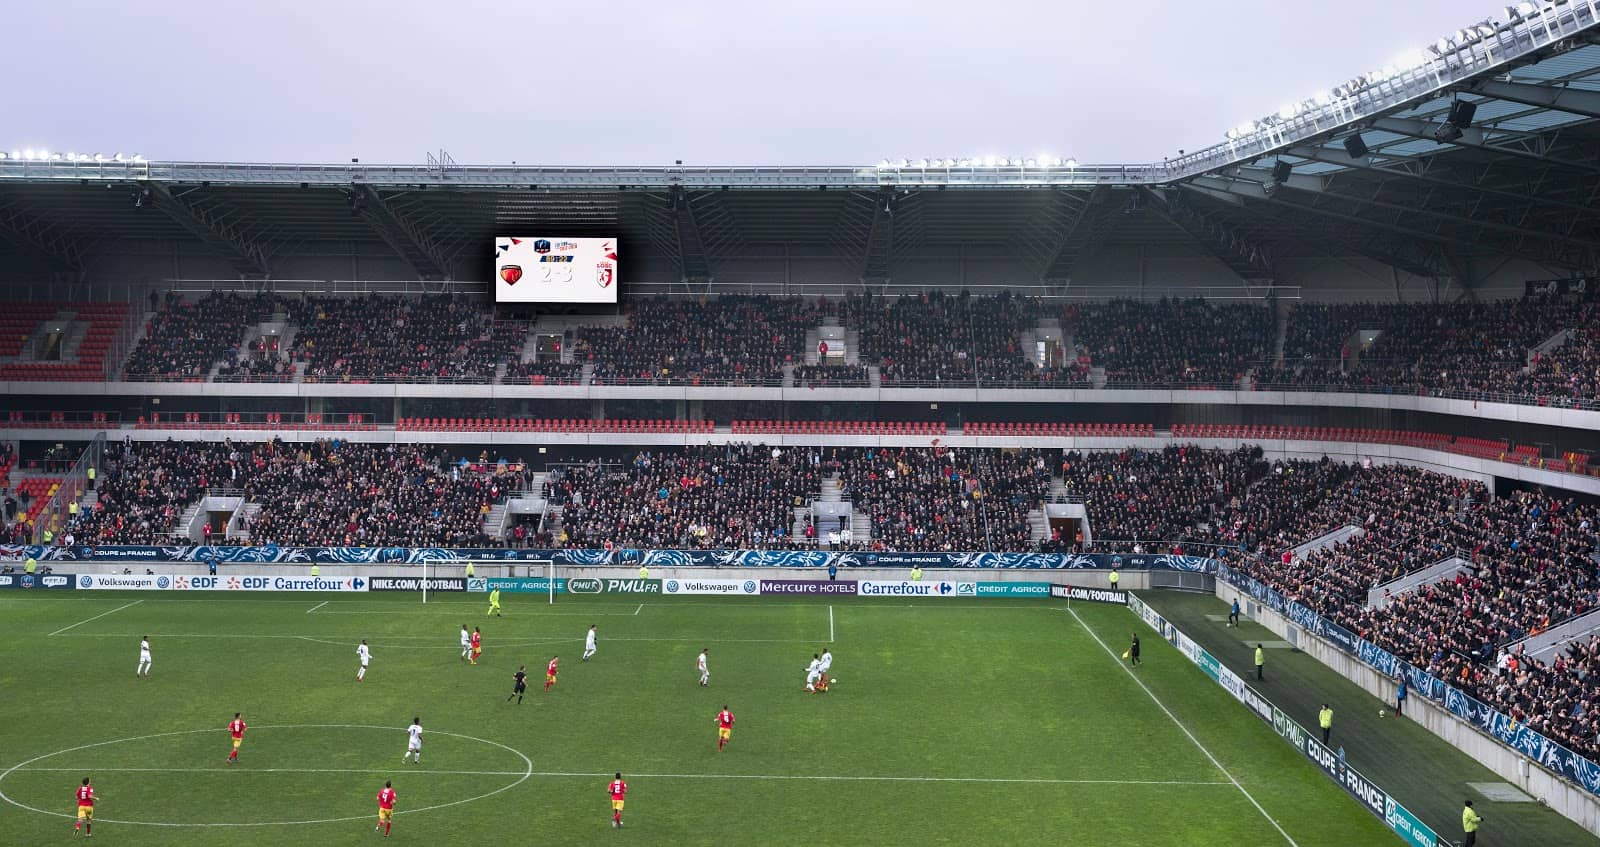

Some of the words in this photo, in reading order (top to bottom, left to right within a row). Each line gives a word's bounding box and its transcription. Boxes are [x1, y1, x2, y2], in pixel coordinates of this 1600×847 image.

[98, 578, 152, 588] Volkswagen
[274, 577, 343, 590] Carrefour
[372, 579, 463, 590] NIKE.COM/FOOTBALL
[572, 581, 590, 590] PMU
[685, 582, 738, 593] Volkswagen
[761, 582, 816, 593] Mercure
[820, 584, 855, 593] HOTELS
[862, 581, 930, 594] Carrefour
[978, 583, 1008, 593] CRÉDIT
[1308, 738, 1335, 776] COUPE
[1346, 770, 1383, 815] FRANCE
